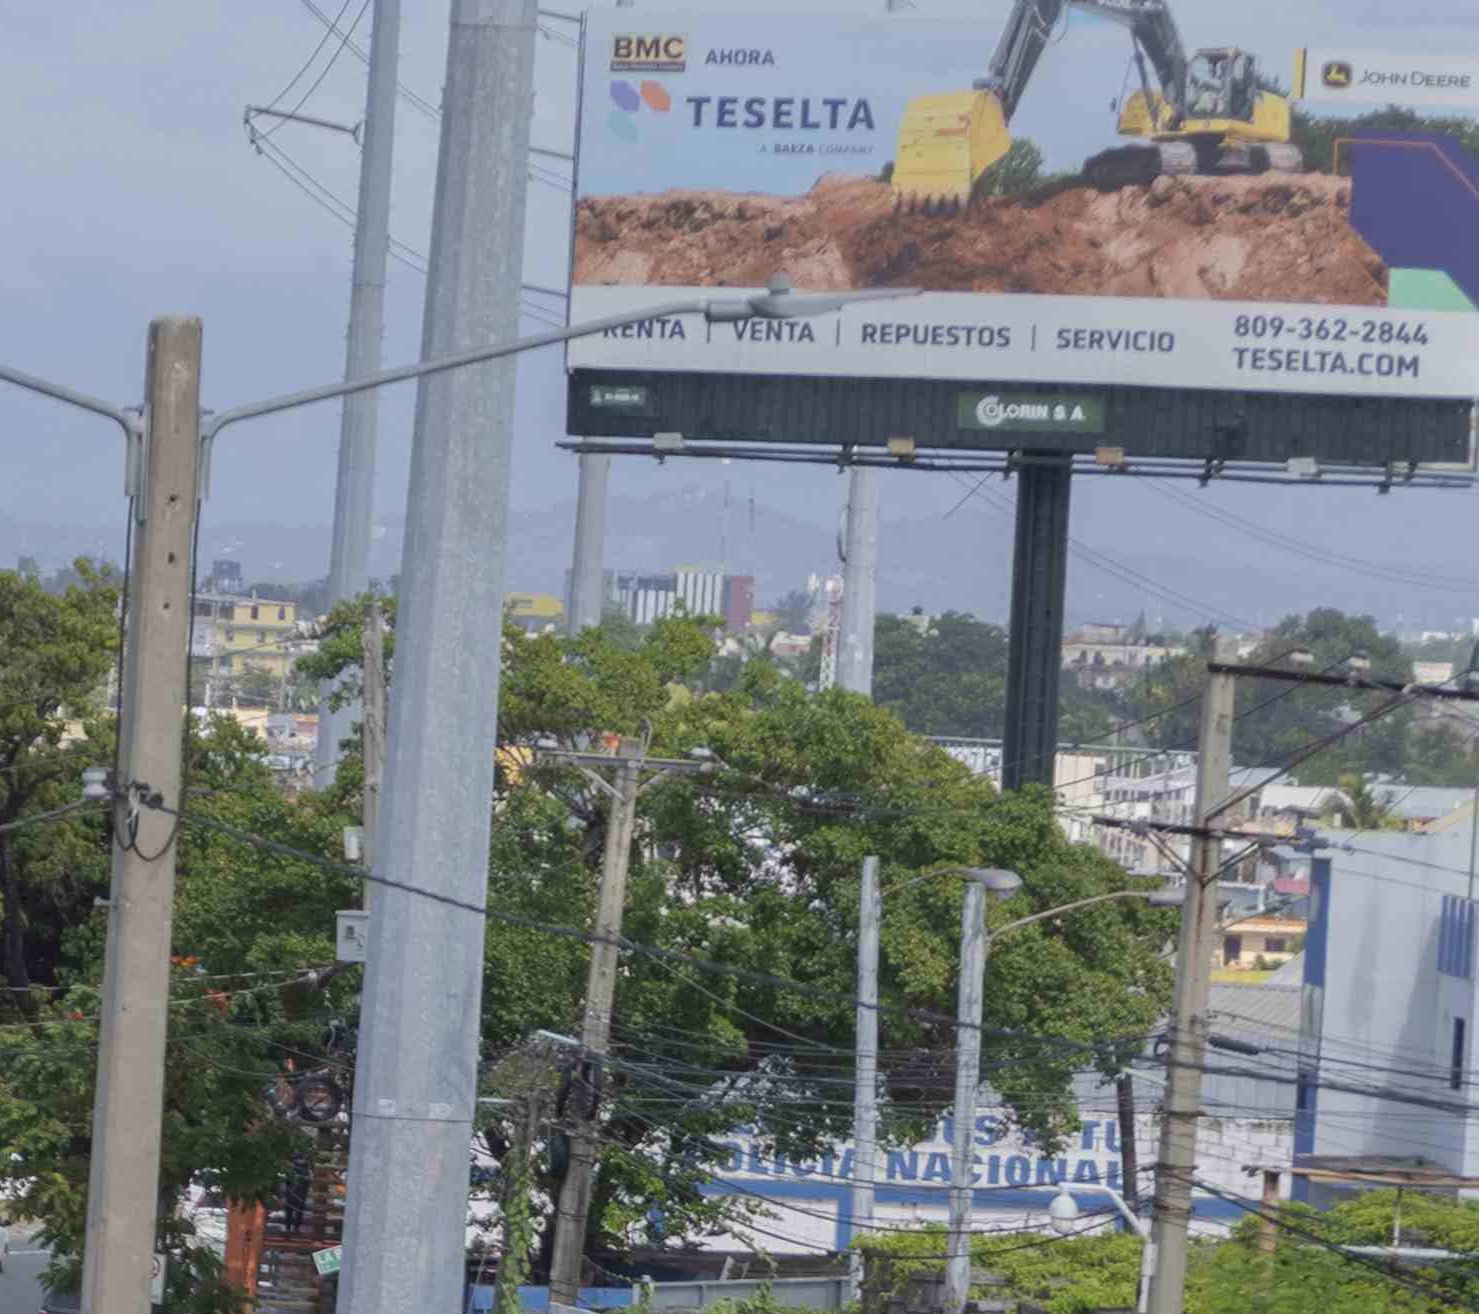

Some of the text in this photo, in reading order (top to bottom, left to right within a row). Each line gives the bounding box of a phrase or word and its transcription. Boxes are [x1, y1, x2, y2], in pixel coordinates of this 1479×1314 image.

[614, 36, 684, 59] BMC
[705, 48, 775, 65] AHORA
[1359, 68, 1472, 88] JOHN DEERE
[686, 96, 876, 131] TESELTA
[774, 143, 815, 154] BAEZA
[603, 317, 1176, 353] RENTA VENTA REPUESTOS SERVICIO
[1234, 314, 1431, 346] 809-362-2844
[1232, 346, 1421, 378] TESELTA.COM
[709, 1140, 1123, 1190] OLICIA NACIONAL
